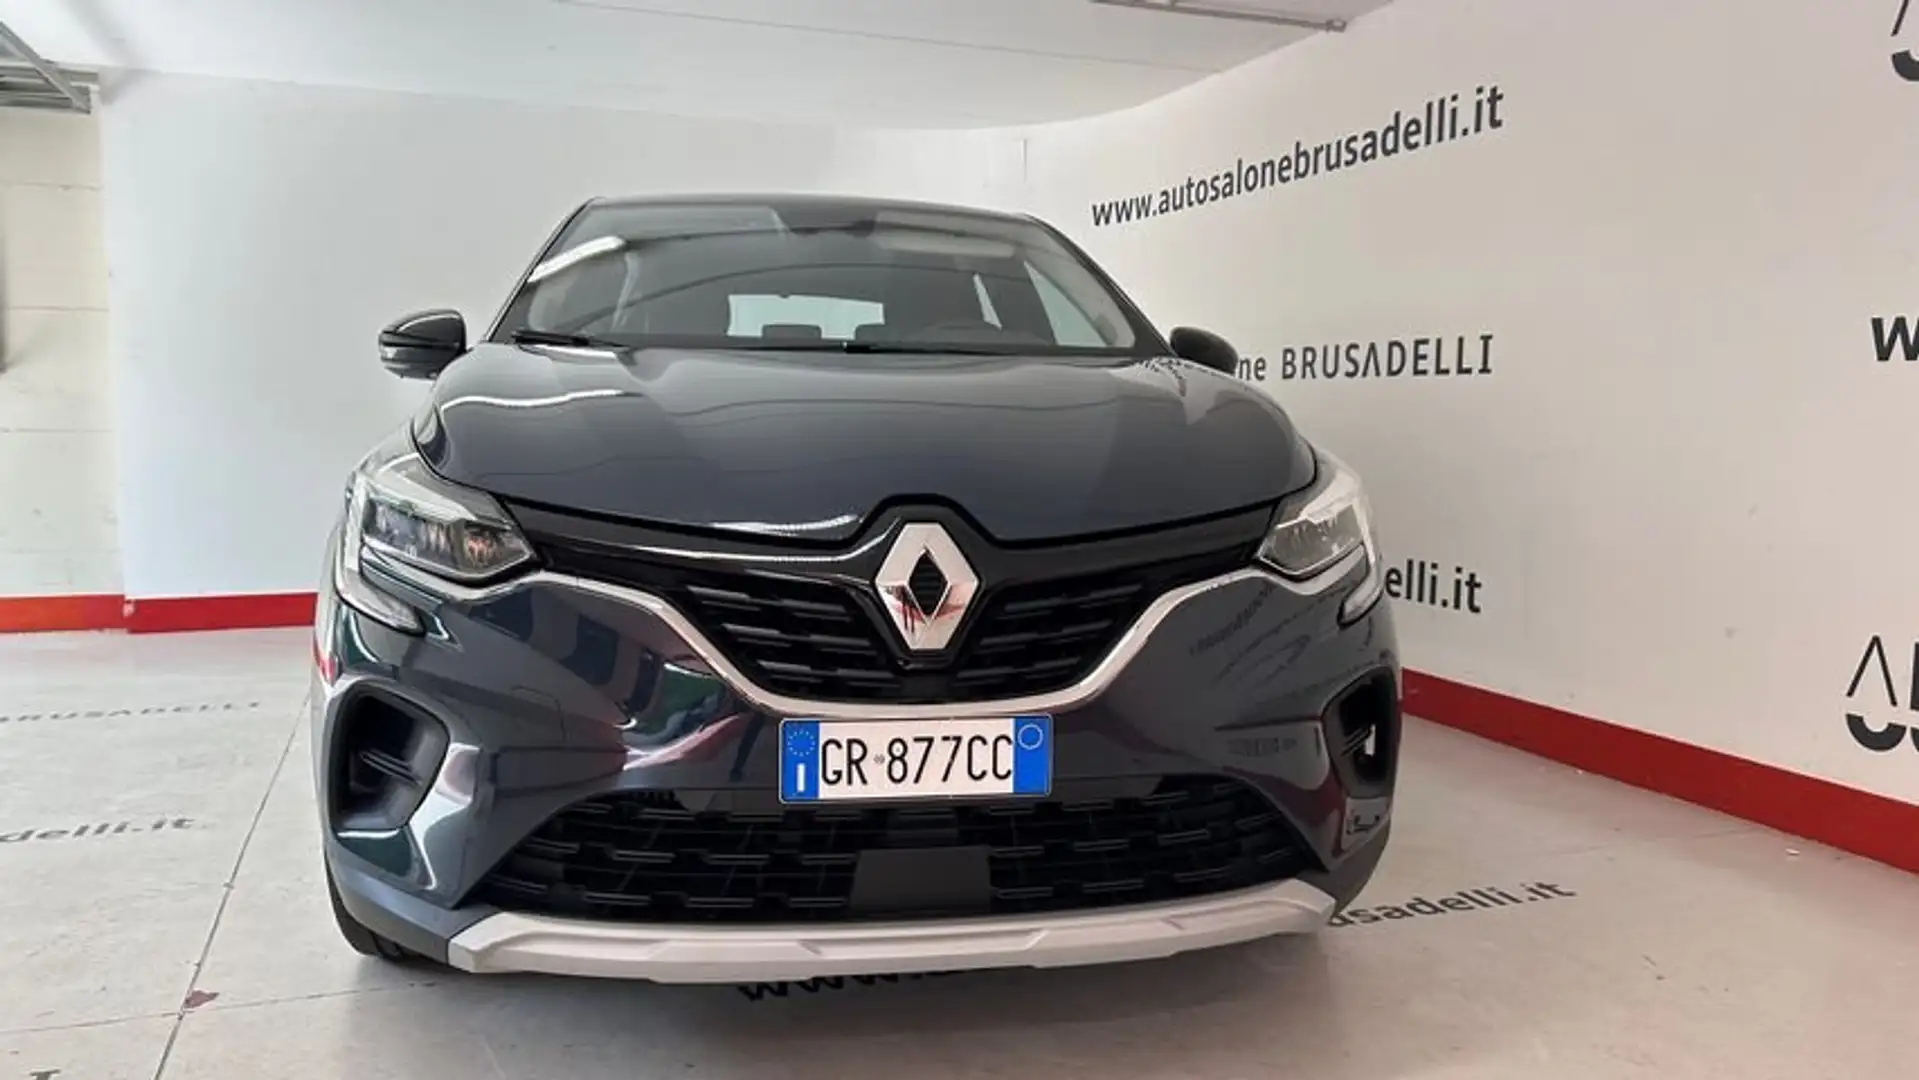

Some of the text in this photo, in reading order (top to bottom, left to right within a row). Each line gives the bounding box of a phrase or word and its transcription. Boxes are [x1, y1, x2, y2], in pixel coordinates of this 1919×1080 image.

[1091, 85, 1504, 227] www.autosalonebrusadelli.it
[1239, 334, 1494, 382] ne BRUSADELLI
[1384, 559, 1483, 614] elli.it
[821, 737, 868, 786] GR
[887, 733, 1013, 785] 877CC
